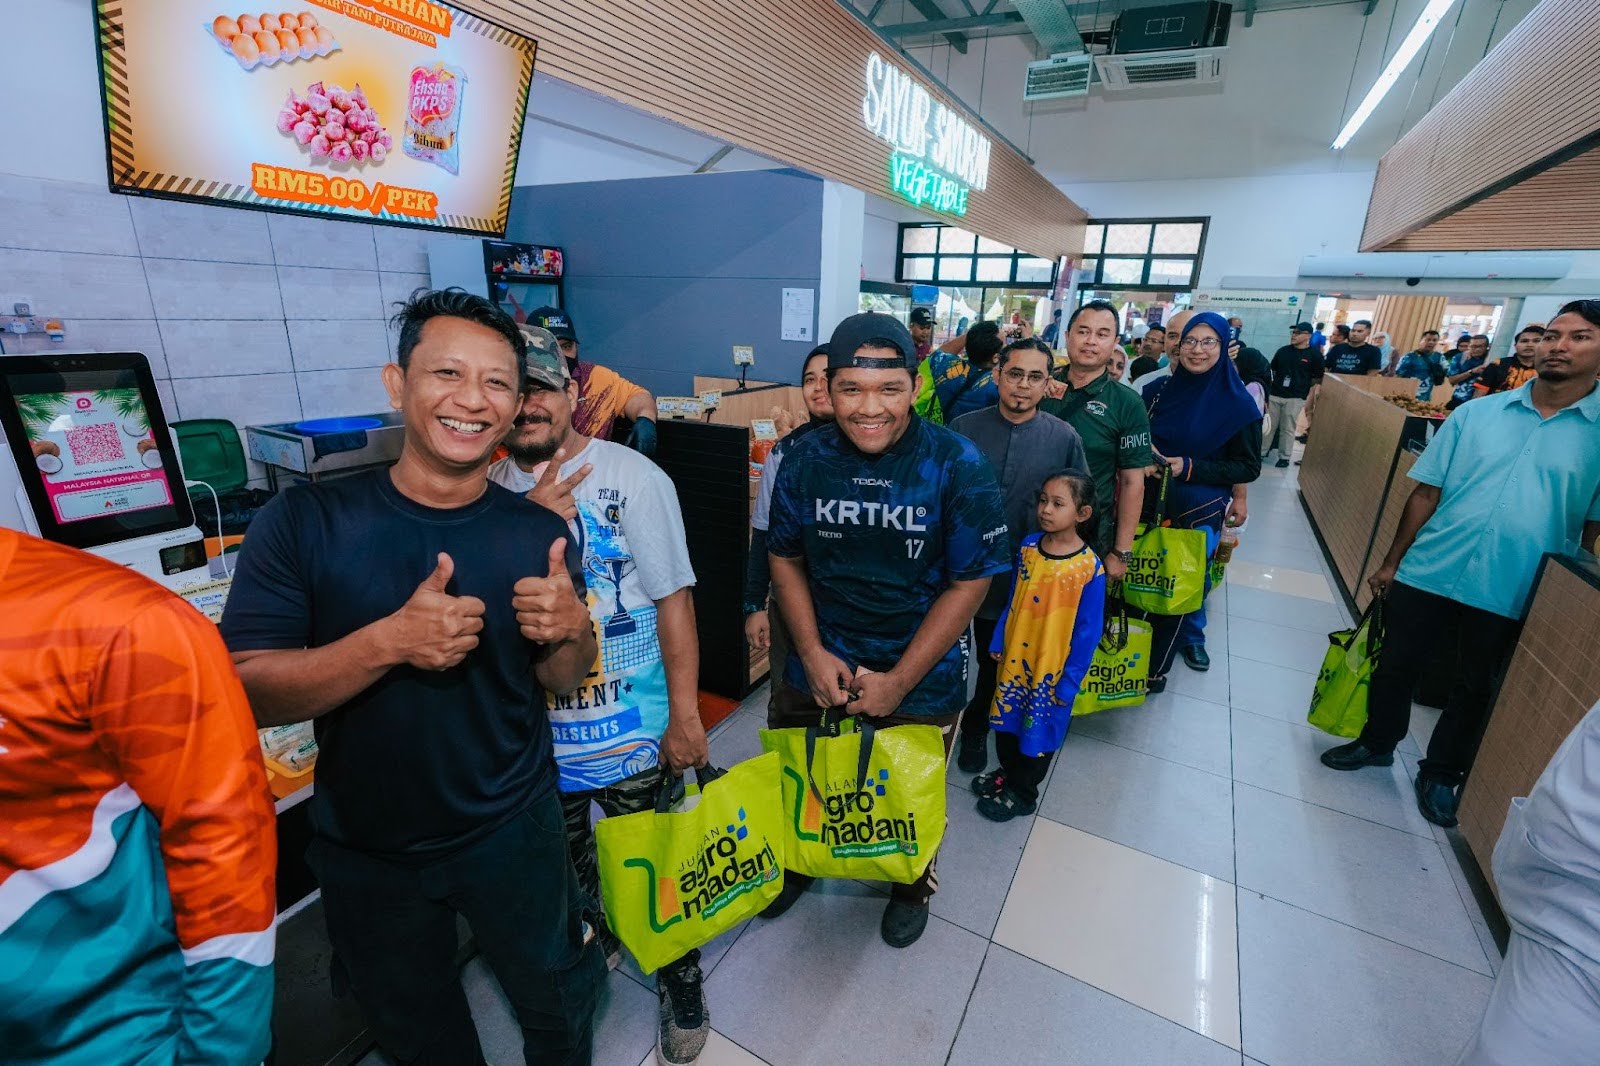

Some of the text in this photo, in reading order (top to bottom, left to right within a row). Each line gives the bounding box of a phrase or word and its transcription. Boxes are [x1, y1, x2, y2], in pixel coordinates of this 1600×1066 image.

[343, 4, 373, 21] TANI
[374, 14, 435, 44] PUTRAJAYA
[412, 95, 448, 111] PKPS
[254, 166, 365, 203] RM5.00
[386, 188, 433, 212] PEK
[891, 152, 969, 214] VEGETABLE
[63, 480, 102, 490] MALAYSIA
[103, 474, 139, 485] NATIONAL
[905, 538, 925, 560] 17
[1089, 663, 1127, 682] agro
[679, 836, 738, 894] agro
